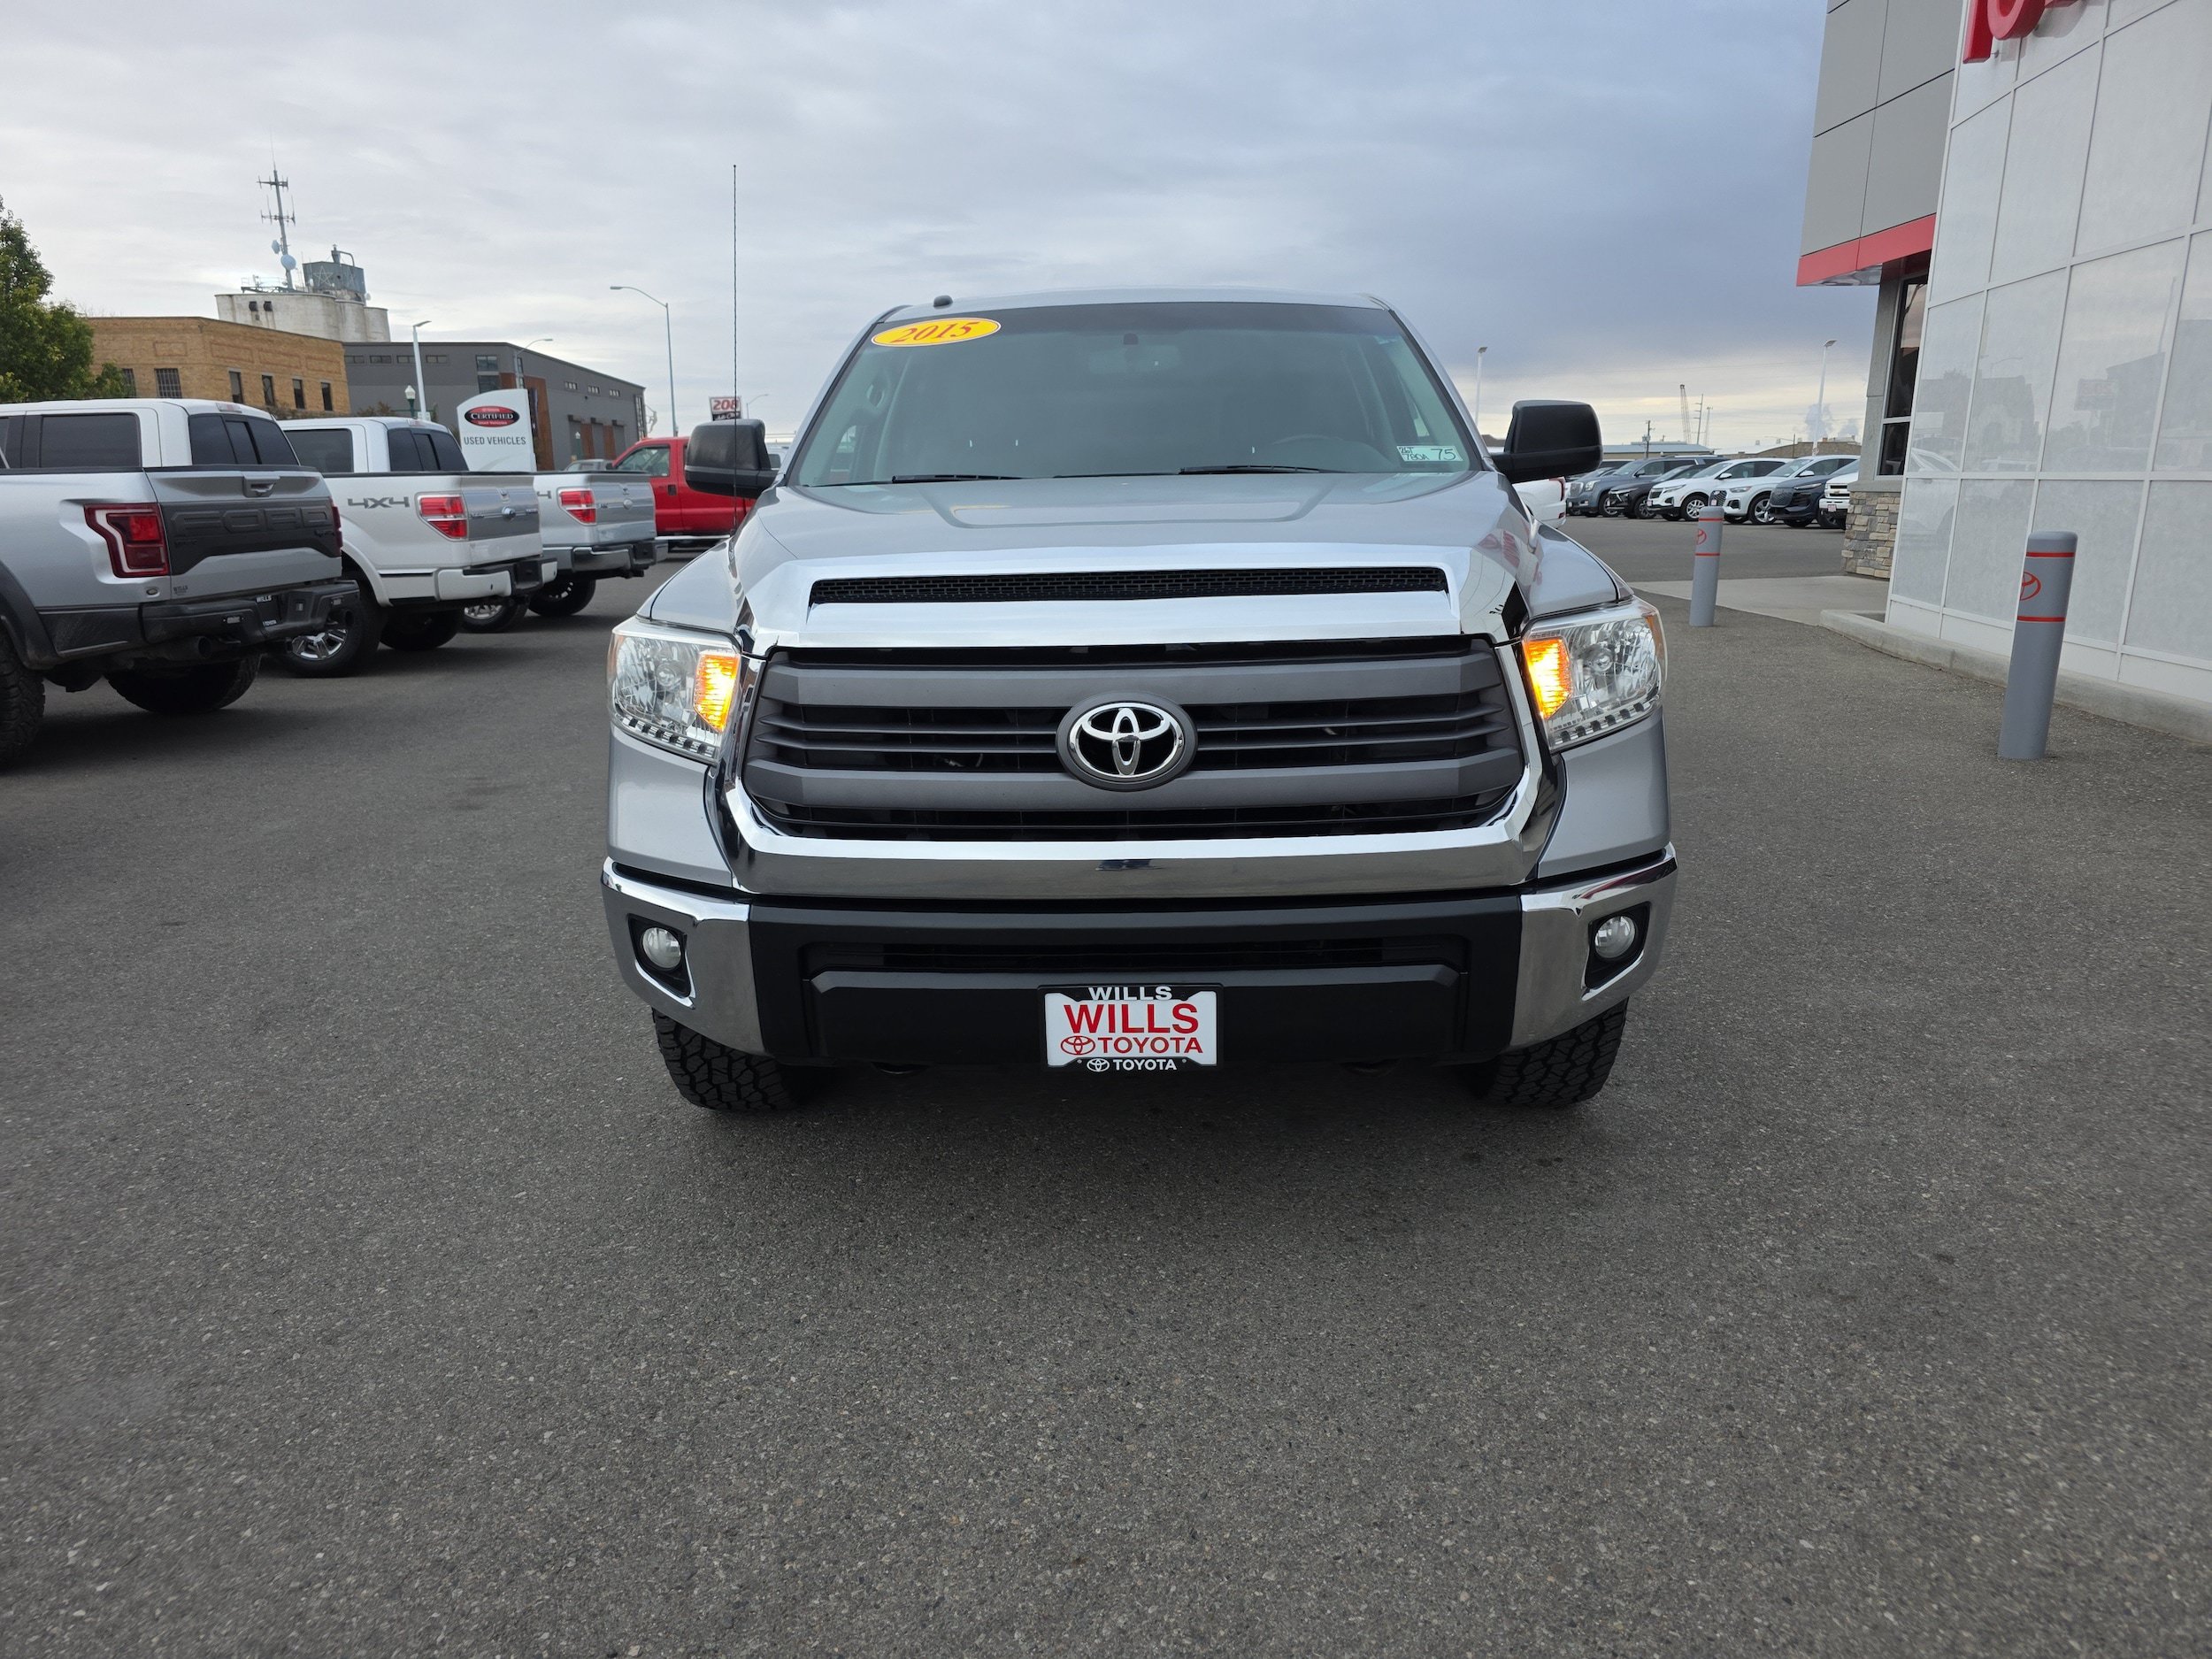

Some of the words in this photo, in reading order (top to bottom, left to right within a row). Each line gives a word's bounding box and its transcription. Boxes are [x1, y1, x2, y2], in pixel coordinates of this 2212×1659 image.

[890, 321, 980, 343] 2015
[712, 399, 740, 411] 208
[464, 436, 485, 445] USED
[487, 436, 526, 445] VEHICLES
[1431, 448, 1456, 461] 75
[171, 505, 335, 534] FORD
[1088, 986, 1173, 1001] WILLS
[1064, 1002, 1199, 1033] WILLS
[1097, 1036, 1203, 1054] TOYOTA
[1112, 1059, 1178, 1071] TOYOTA
